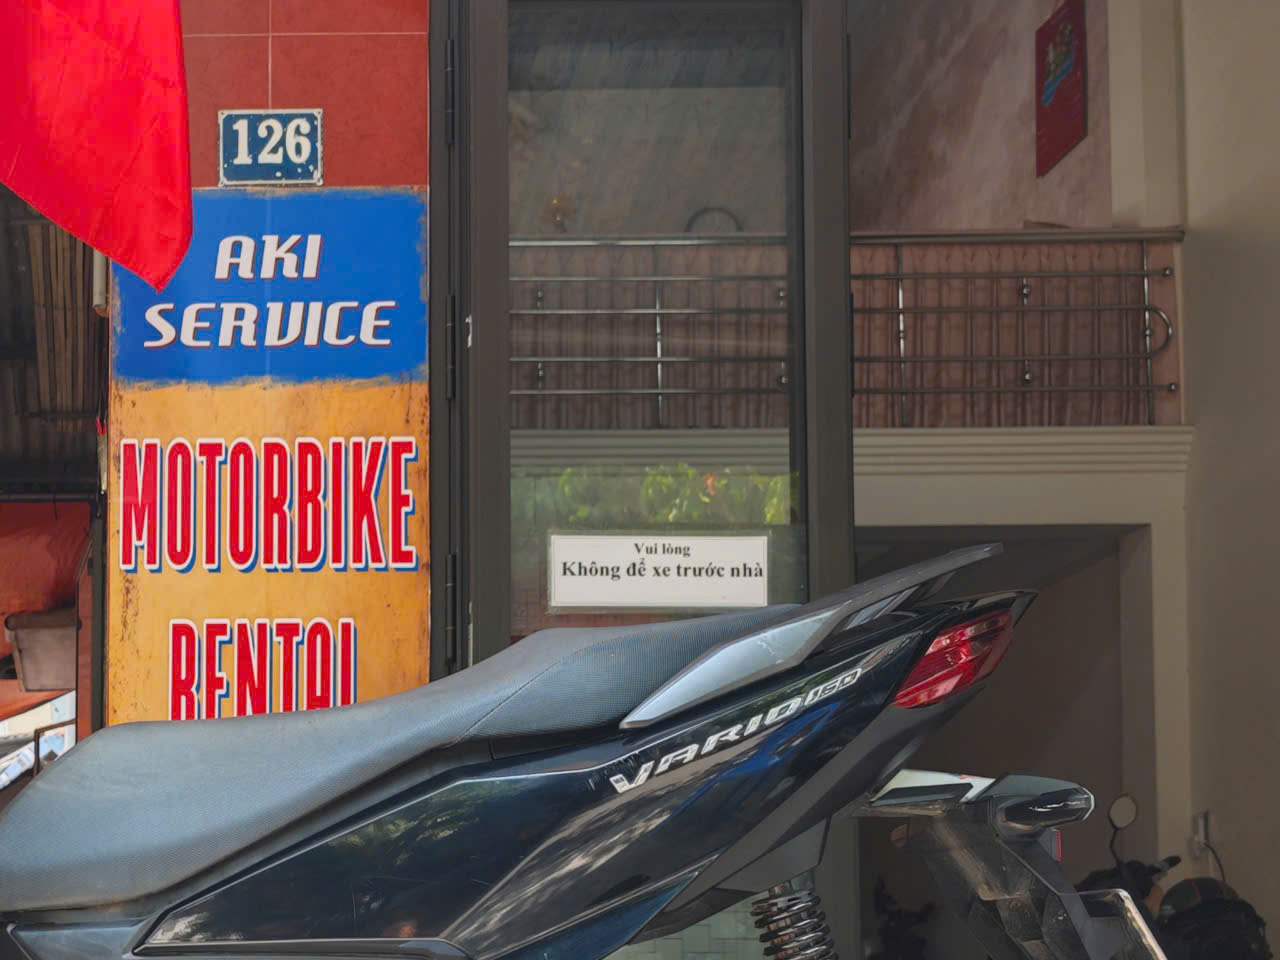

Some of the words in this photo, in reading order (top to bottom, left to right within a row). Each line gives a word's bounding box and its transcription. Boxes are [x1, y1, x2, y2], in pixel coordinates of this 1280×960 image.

[232, 118, 312, 165] 126
[214, 234, 322, 280] AKI
[143, 300, 397, 348] SERVICE
[119, 436, 418, 573] MOTORBIKE
[561, 561, 621, 580] Không
[626, 558, 646, 577] để
[652, 565, 671, 577] xe
[676, 562, 725, 577] trước
[730, 562, 763, 577] nhà
[634, 543, 658, 555] Vui
[662, 543, 691, 557] lòng
[609, 697, 802, 793] VARIO
